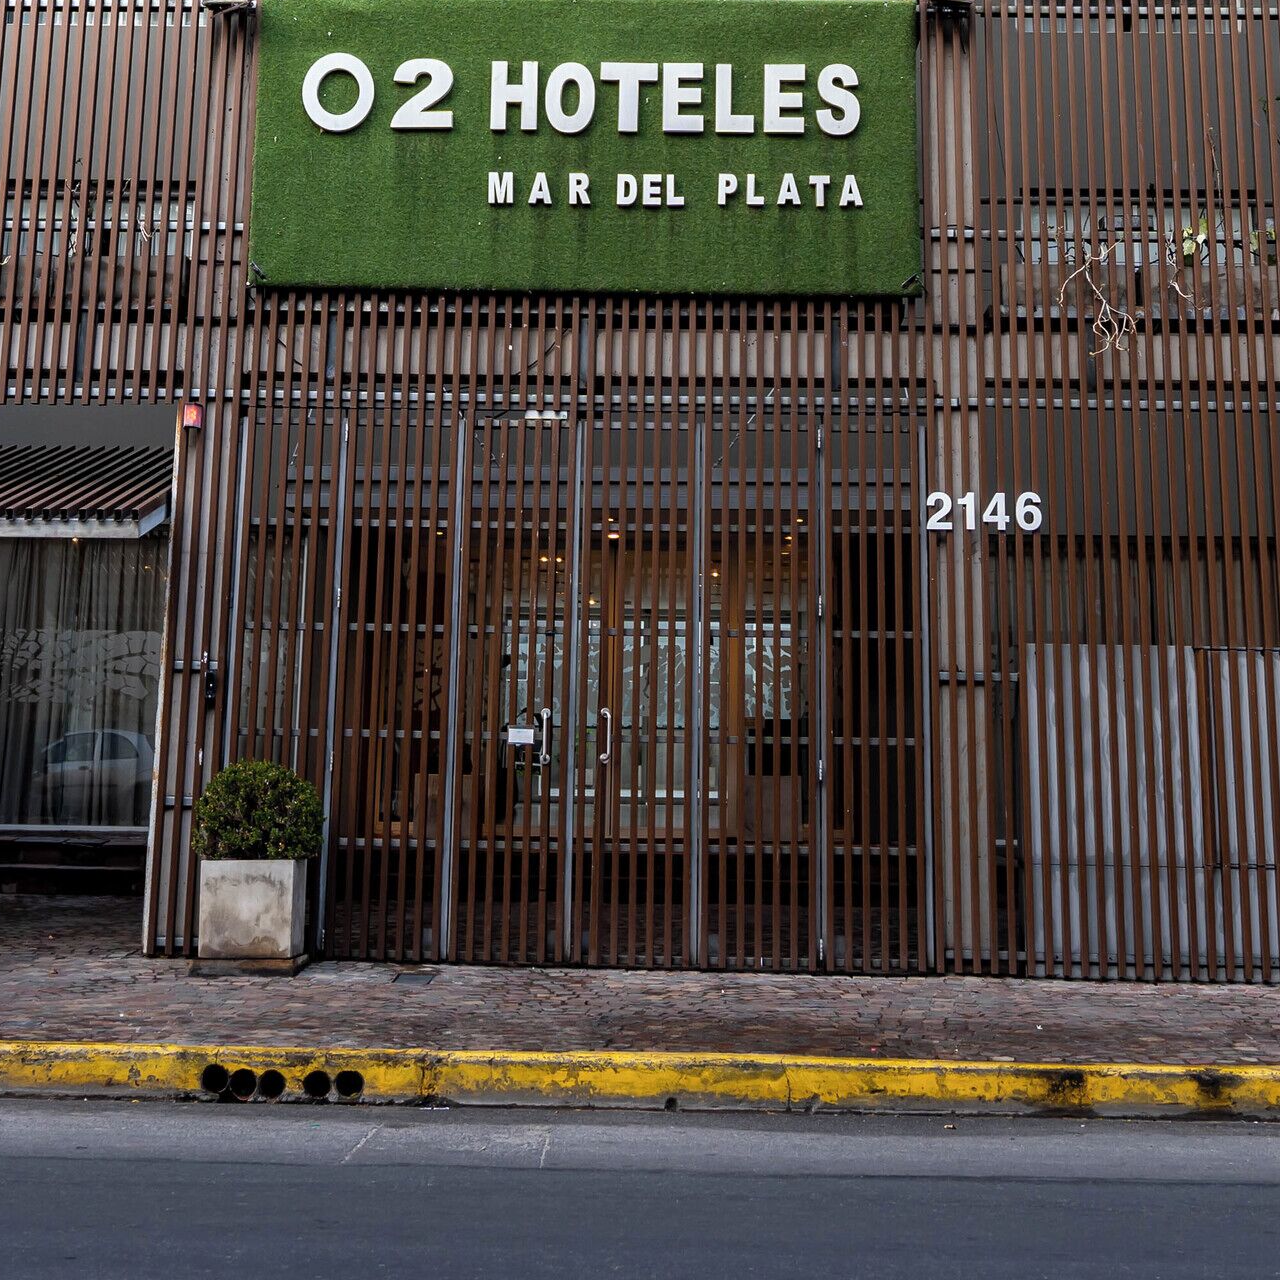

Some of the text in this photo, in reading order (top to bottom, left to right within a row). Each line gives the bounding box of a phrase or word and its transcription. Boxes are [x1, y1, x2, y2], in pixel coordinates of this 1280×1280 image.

[489, 60, 861, 137] HOTELES
[487, 171, 864, 208] MAR DEL PLATA
[926, 491, 1043, 531] 2146
